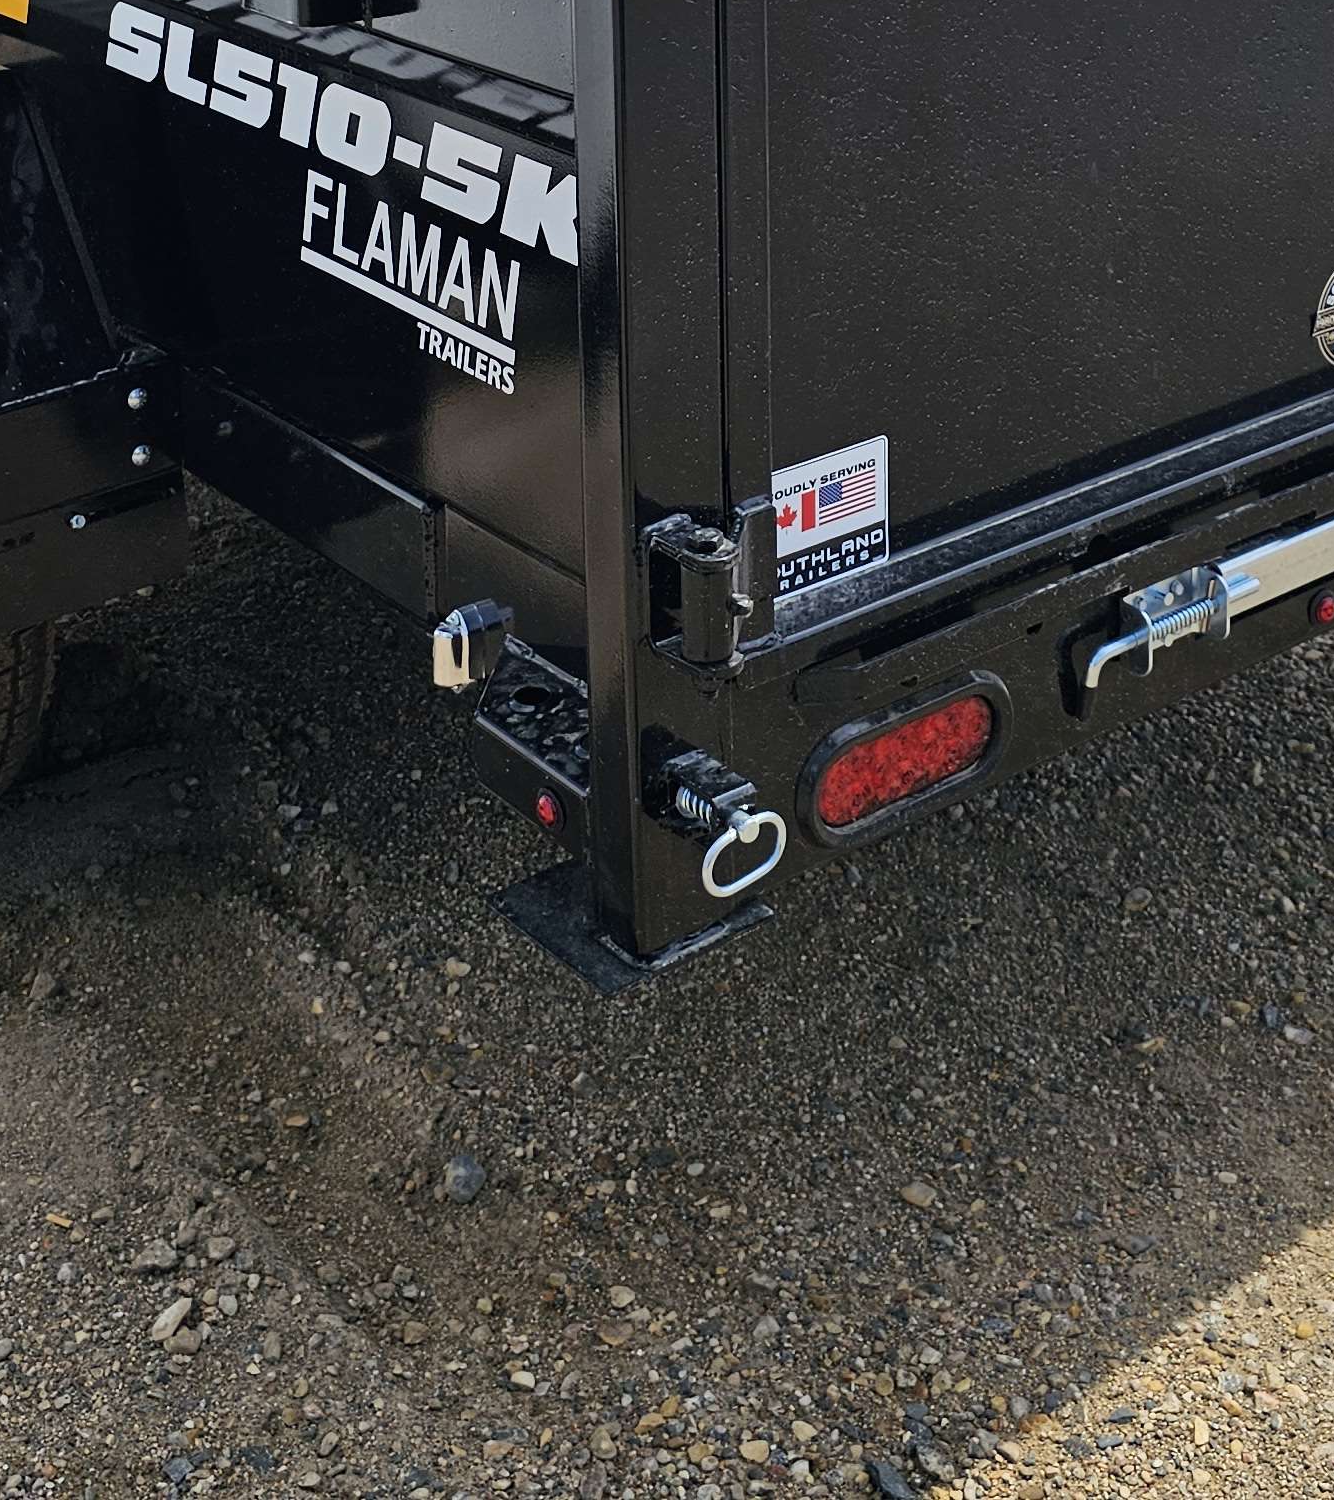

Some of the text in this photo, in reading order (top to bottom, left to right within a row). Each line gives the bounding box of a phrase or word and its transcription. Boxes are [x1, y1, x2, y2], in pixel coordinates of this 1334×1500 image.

[302, 169, 520, 341] FLAMAN
[416, 321, 515, 395] TRAILERS
[773, 458, 876, 501] OUDLY SERVING
[777, 528, 884, 579] UTHLAND
[779, 549, 870, 591] RAILERS
